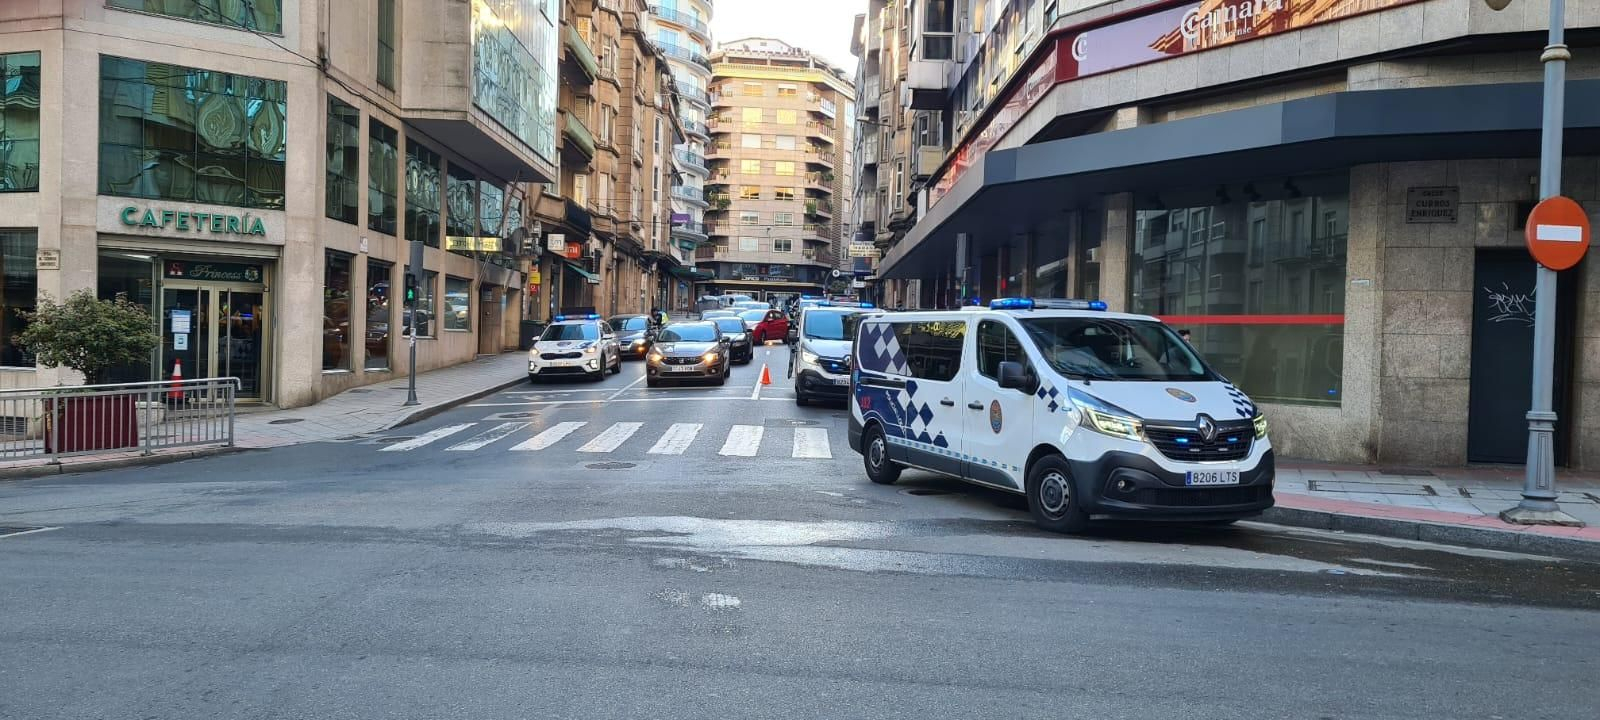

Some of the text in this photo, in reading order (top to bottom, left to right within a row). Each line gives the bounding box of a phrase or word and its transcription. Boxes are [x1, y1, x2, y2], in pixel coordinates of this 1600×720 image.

[120, 206, 267, 236] CAFETERÍA
[1192, 471, 1238, 483] 8206 LTS
